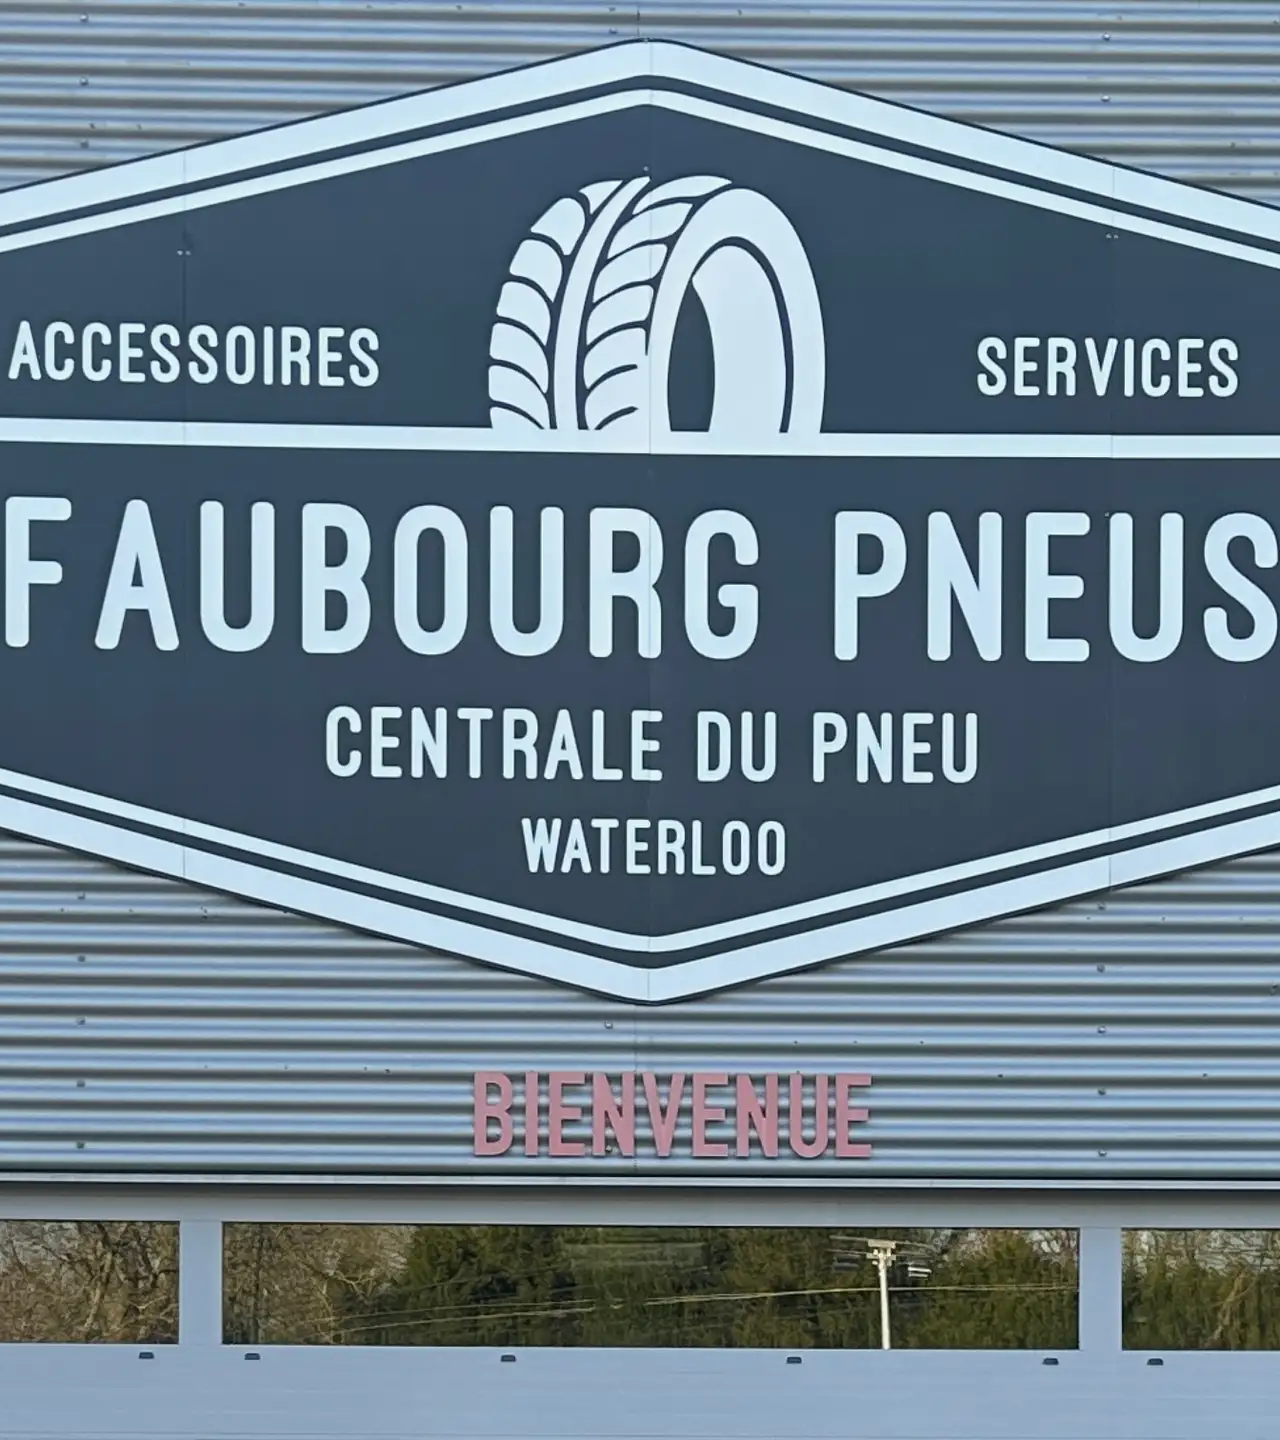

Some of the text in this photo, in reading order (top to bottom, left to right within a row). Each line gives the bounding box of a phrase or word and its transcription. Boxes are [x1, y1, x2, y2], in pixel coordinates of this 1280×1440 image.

[8, 320, 379, 387] ACCESSOIRES
[977, 337, 1239, 398] SERVICES
[5, 496, 1279, 663] FAUBOURG PNEUS
[326, 705, 978, 784] CENTRALE DU PNEU
[521, 817, 786, 876] WATERLOO
[471, 1072, 873, 1159] BIENVENUE
